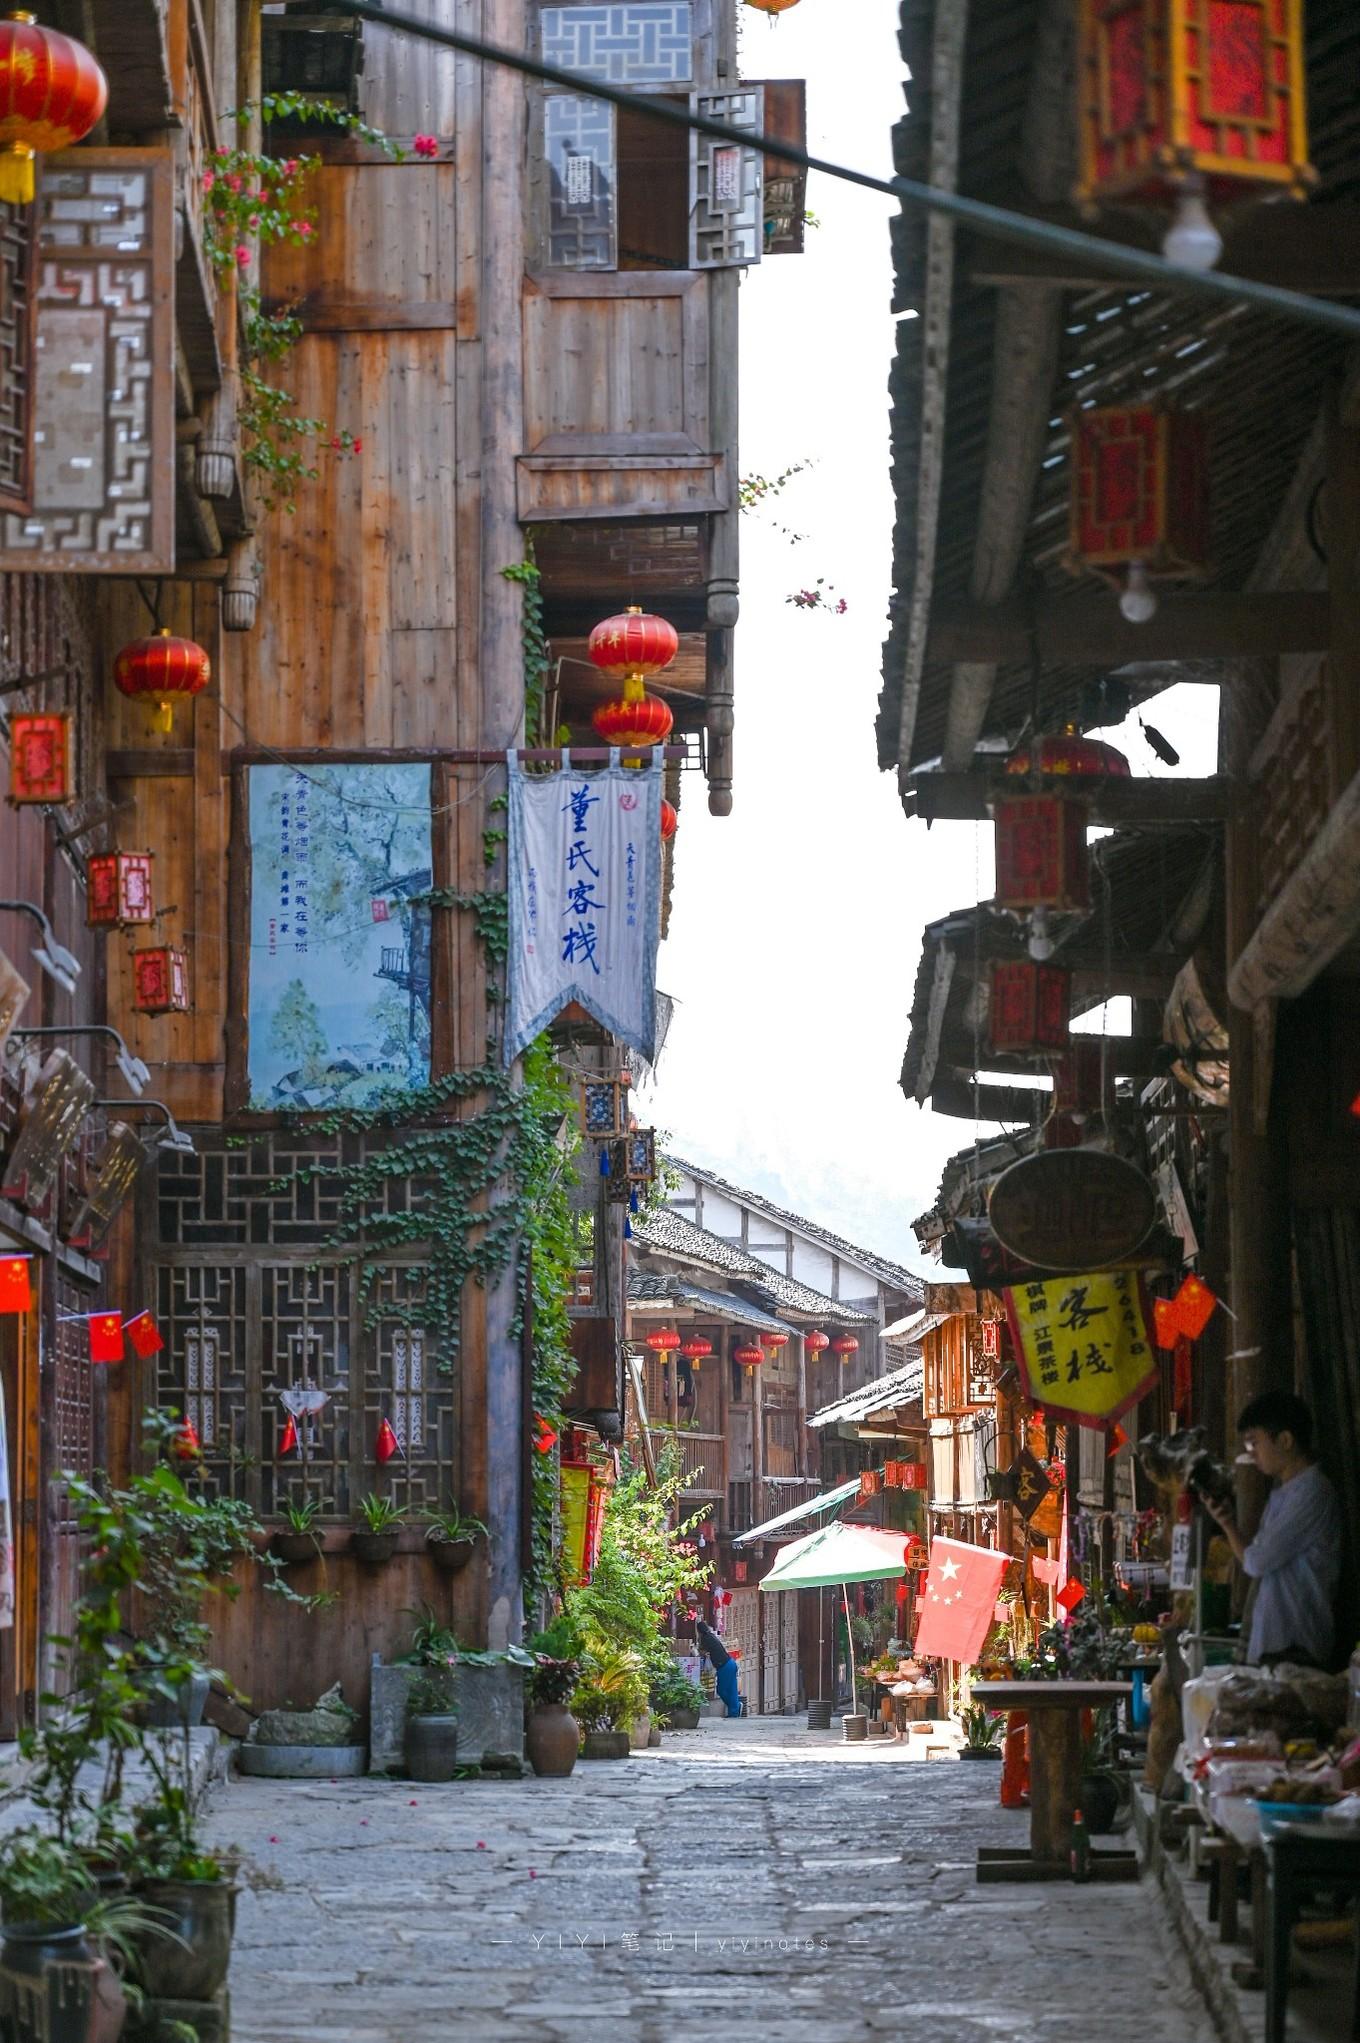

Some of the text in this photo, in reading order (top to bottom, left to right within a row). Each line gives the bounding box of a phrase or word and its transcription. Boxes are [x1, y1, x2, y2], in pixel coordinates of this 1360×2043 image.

[294, 880, 308, 953] 而我在等你
[561, 783, 607, 975] 董氏客栈
[1025, 1281, 1059, 1385] 棋牌 江景茶楼
[1058, 1286, 1113, 1383] 客栈
[1017, 1466, 1038, 1501] 客
